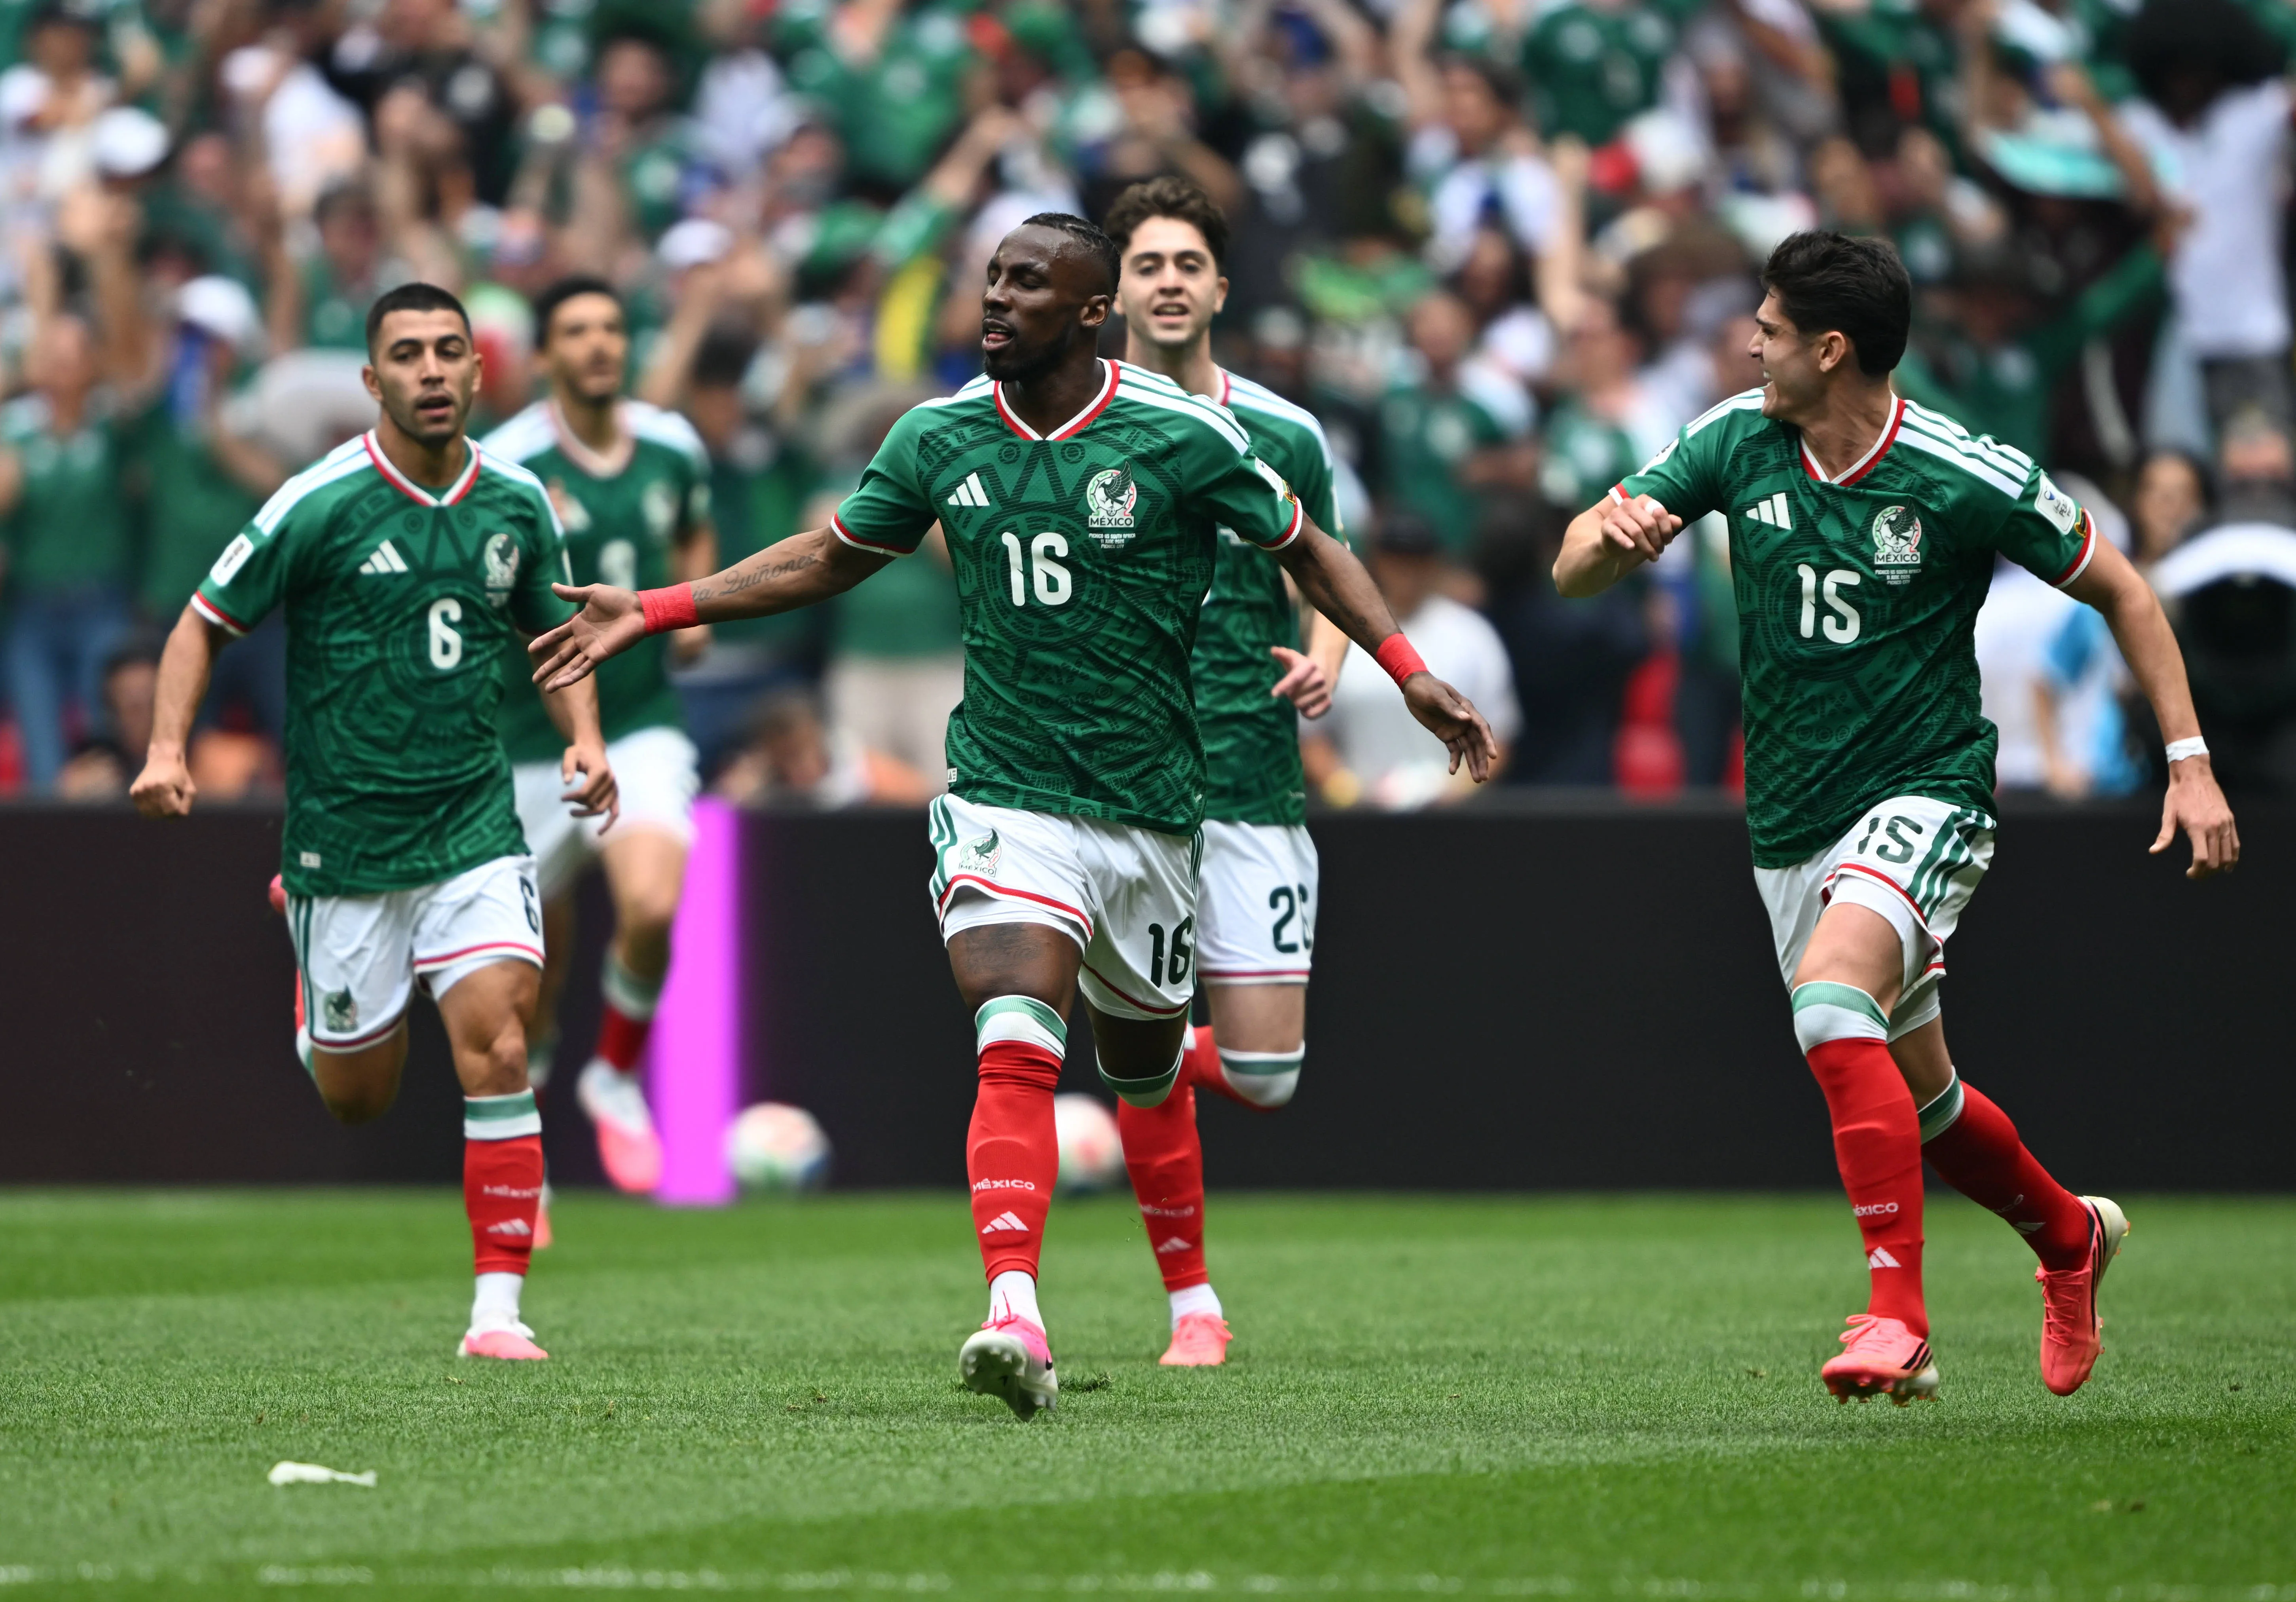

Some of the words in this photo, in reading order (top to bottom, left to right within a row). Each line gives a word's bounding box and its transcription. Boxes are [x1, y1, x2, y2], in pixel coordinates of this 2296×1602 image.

[1090, 516, 1133, 526] MÉXICO
[1002, 532, 1072, 606] 16
[1876, 552, 1918, 562] MÉXICO
[429, 598, 462, 669] 6
[1798, 564, 1861, 643] 15
[1857, 815, 1923, 864] 15
[1148, 916, 1192, 988] 16
[972, 1178, 1035, 1193] MÉXICO
